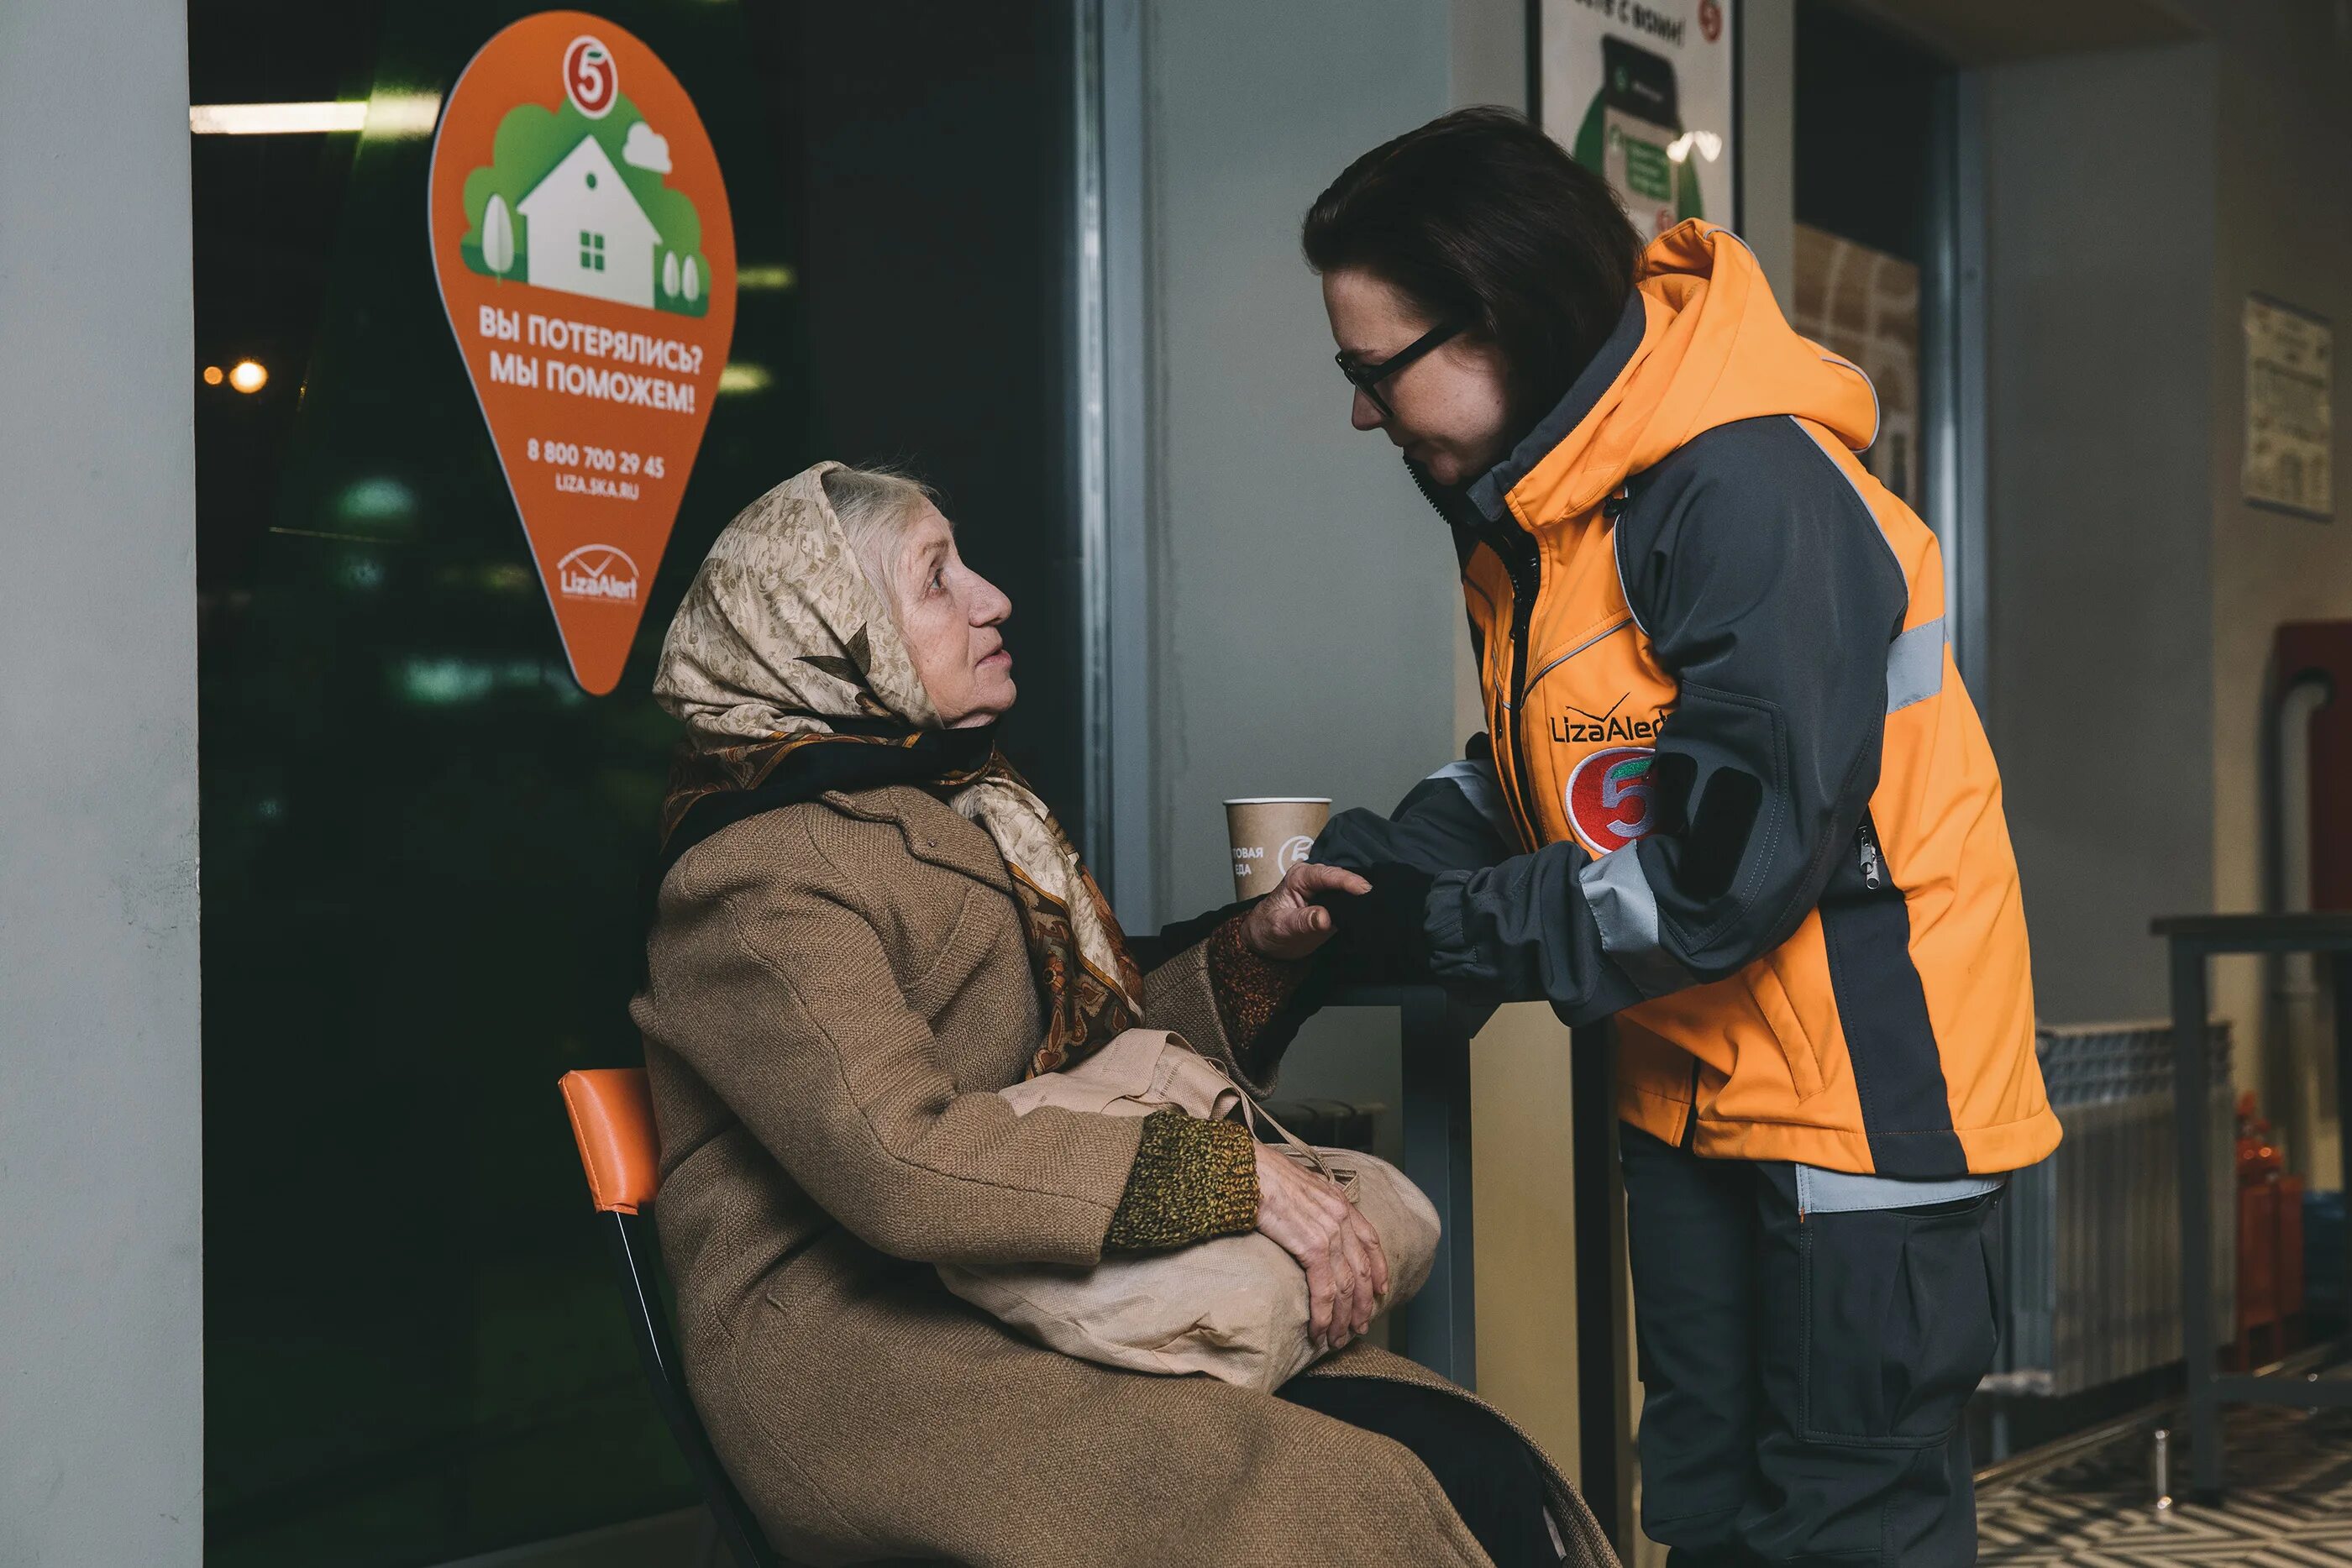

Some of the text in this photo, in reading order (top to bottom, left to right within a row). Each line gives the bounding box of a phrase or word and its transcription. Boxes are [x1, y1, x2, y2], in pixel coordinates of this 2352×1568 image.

[577, 45, 606, 103] 5
[479, 304, 703, 375] ВЫ ПОТЕРЯЛИСЬ?
[490, 349, 696, 415] МЫ ПОМОЖЕМ!
[527, 438, 665, 479] 8 800 700 29 45
[560, 570, 638, 600] LizaAlert
